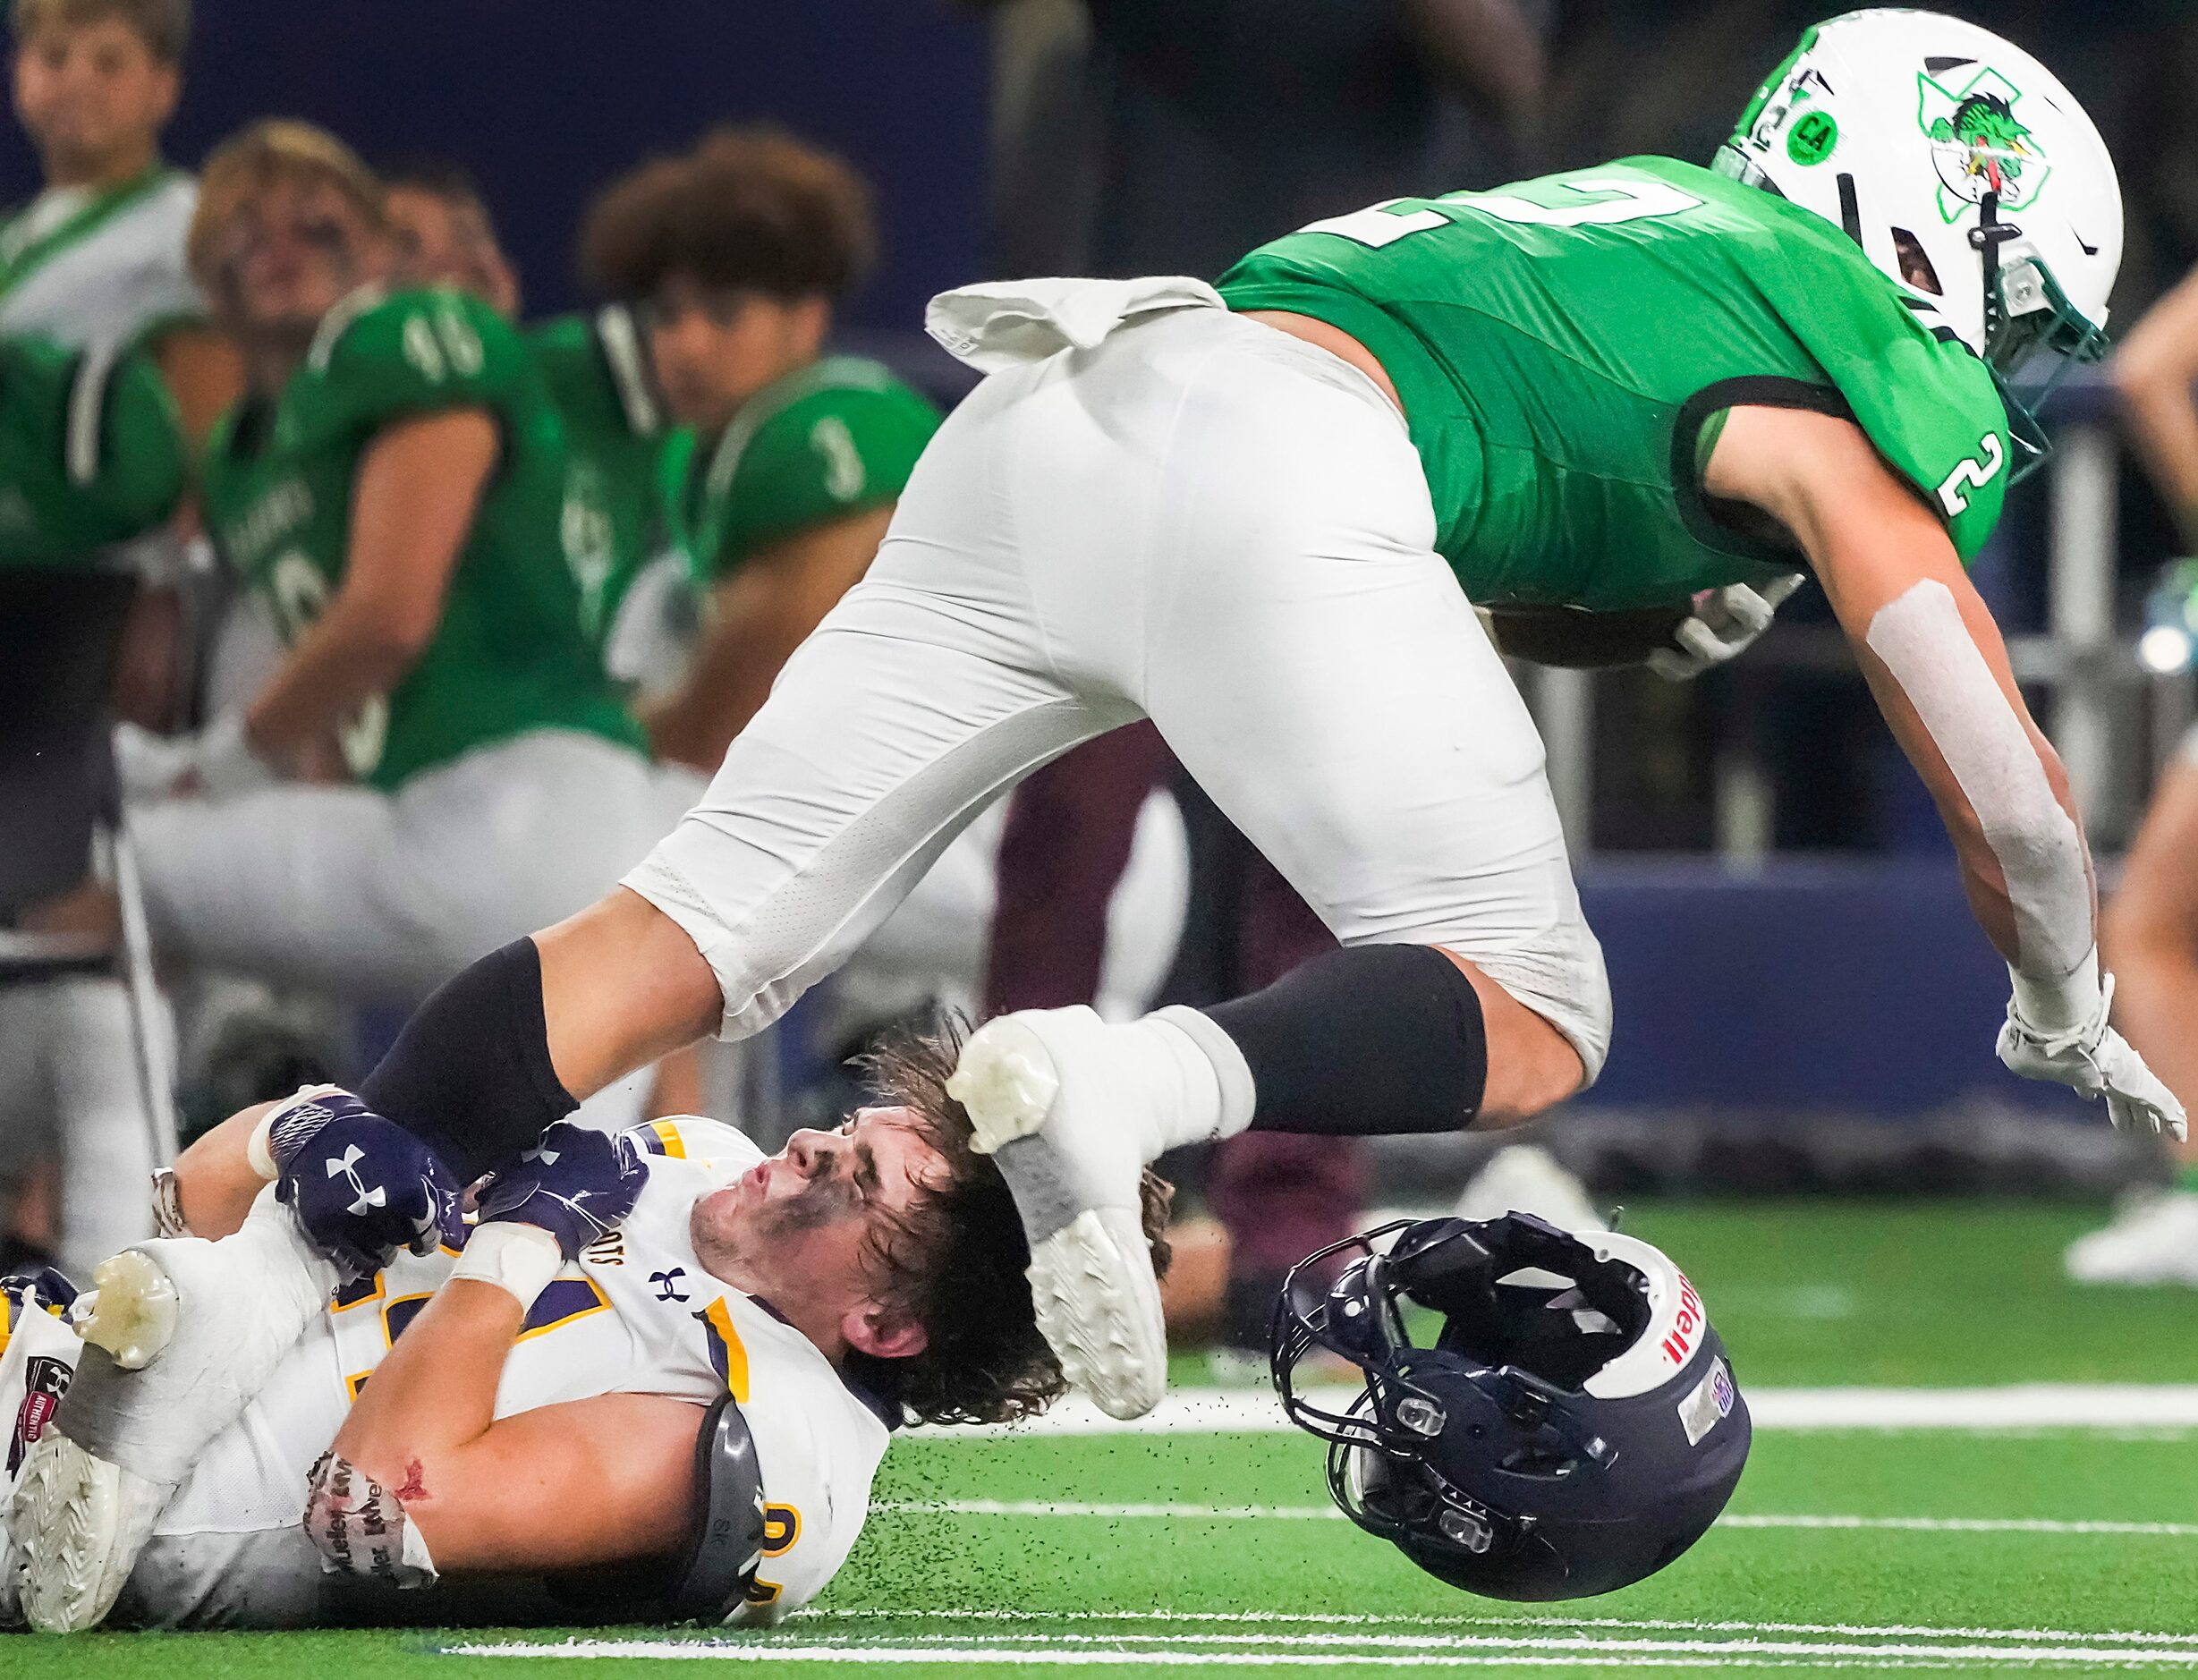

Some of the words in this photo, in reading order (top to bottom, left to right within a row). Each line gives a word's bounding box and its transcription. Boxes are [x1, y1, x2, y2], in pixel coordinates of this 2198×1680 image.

[1796, 115, 1831, 152] CA
[1935, 430, 2003, 517] 2
[587, 1228, 624, 1266] OTS
[27, 1395, 47, 1439] AUTHENTIC
